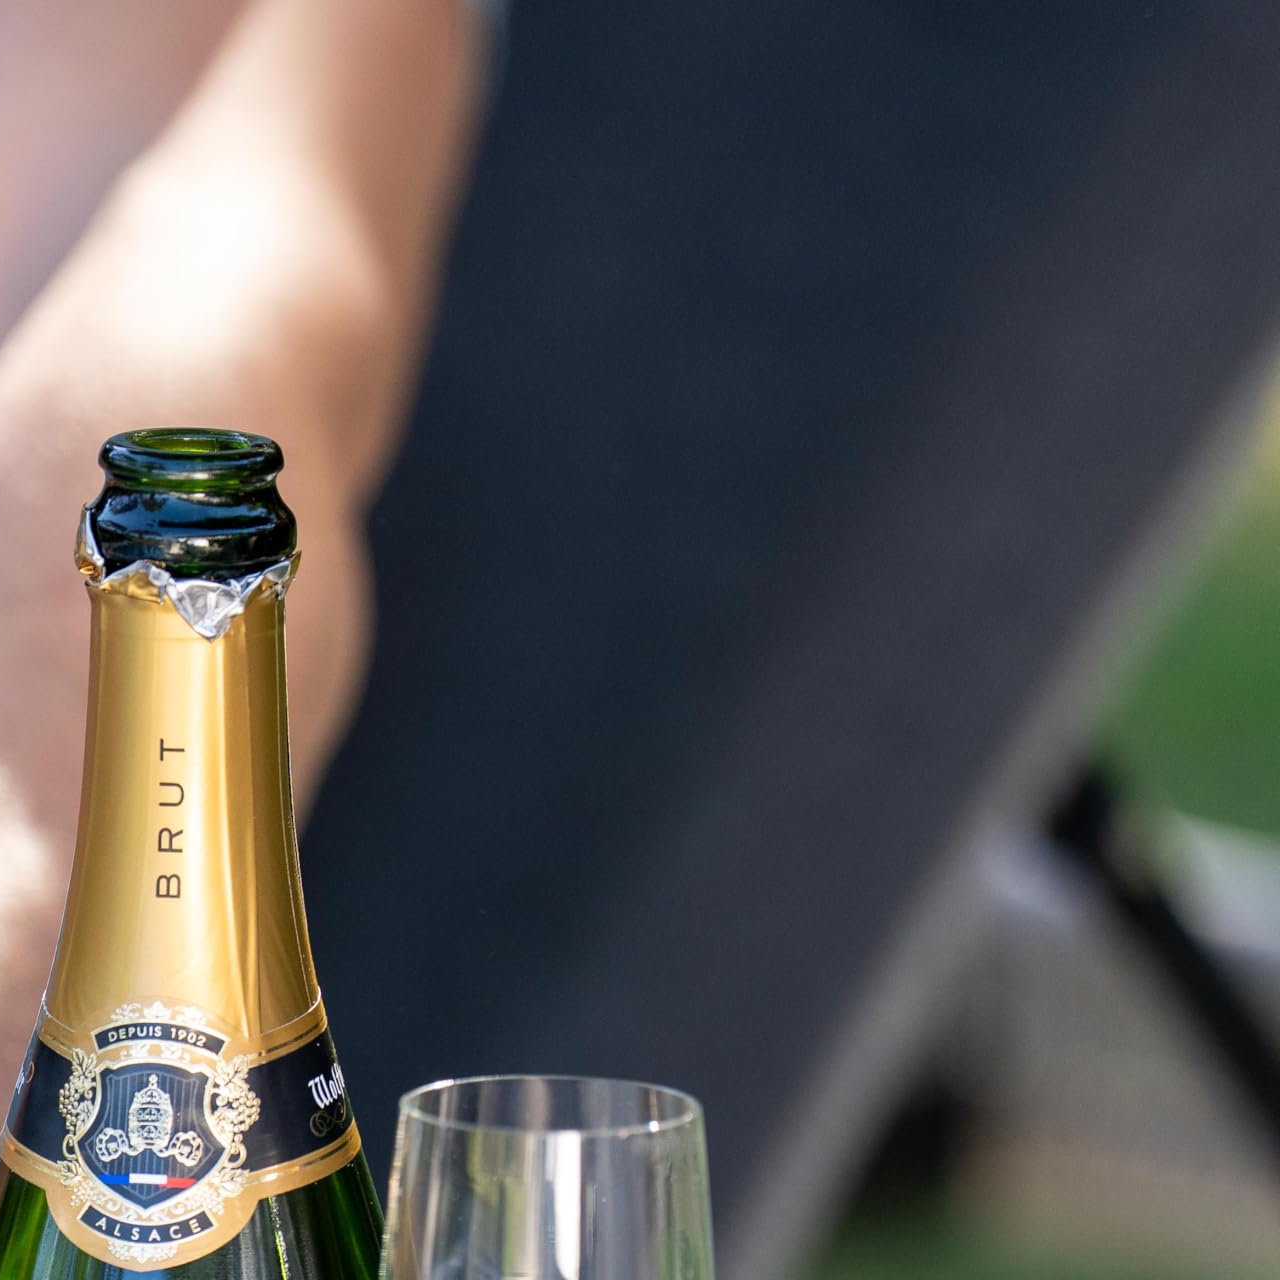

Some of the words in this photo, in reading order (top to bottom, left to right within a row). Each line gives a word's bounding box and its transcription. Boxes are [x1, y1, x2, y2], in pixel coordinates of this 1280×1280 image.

[156, 738, 185, 898] BRUT
[108, 1026, 162, 1043] DEPUIS
[170, 1027, 207, 1047] 1902
[95, 1217, 201, 1242] ALSACE
